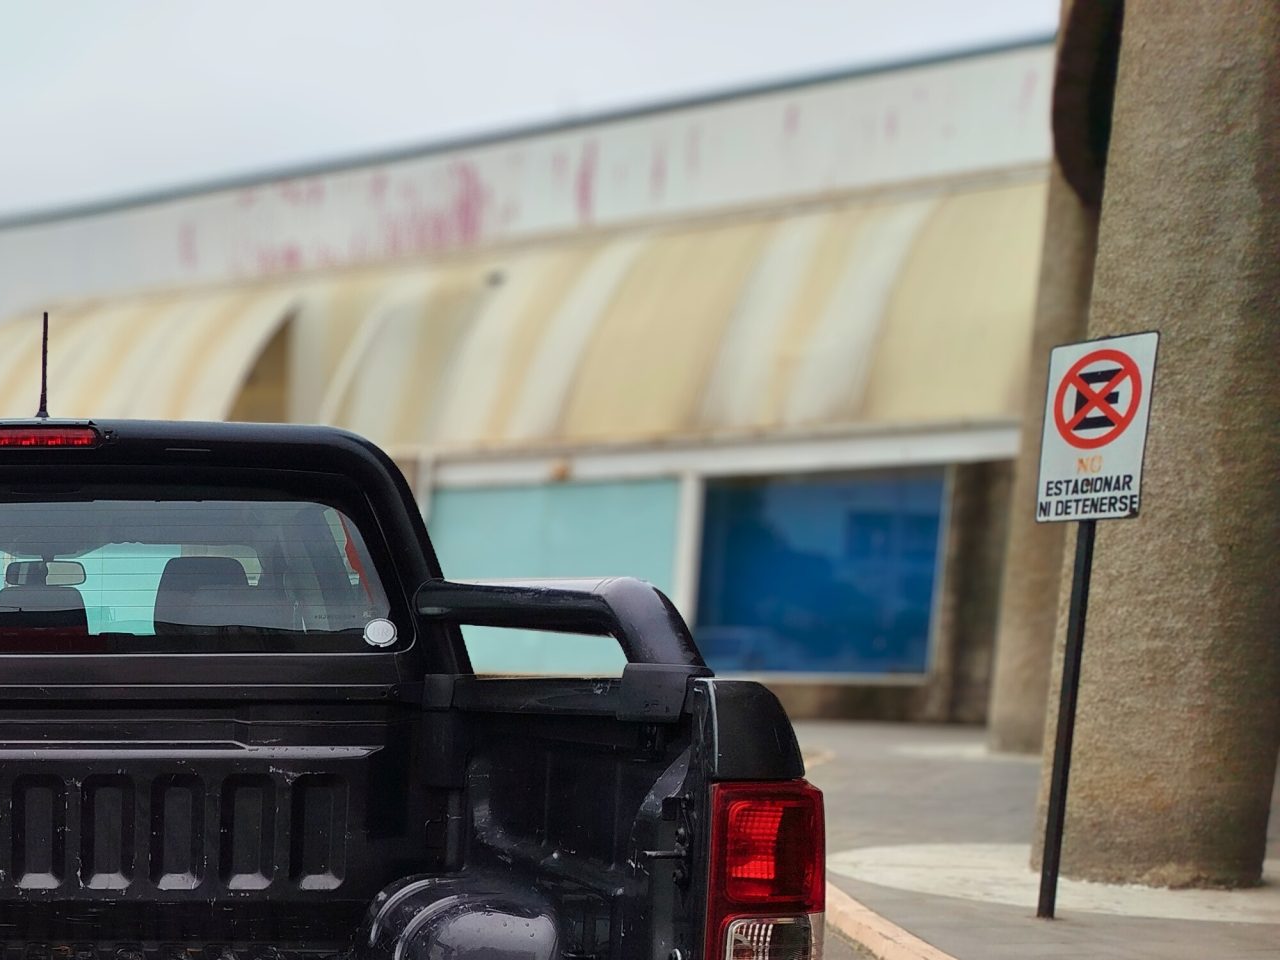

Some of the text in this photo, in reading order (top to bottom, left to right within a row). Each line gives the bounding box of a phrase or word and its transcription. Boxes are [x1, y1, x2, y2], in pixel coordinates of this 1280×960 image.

[1076, 455, 1104, 474] NO
[1045, 474, 1133, 497] ESTACIONAR
[1038, 494, 1138, 517] NI DETENERSE
